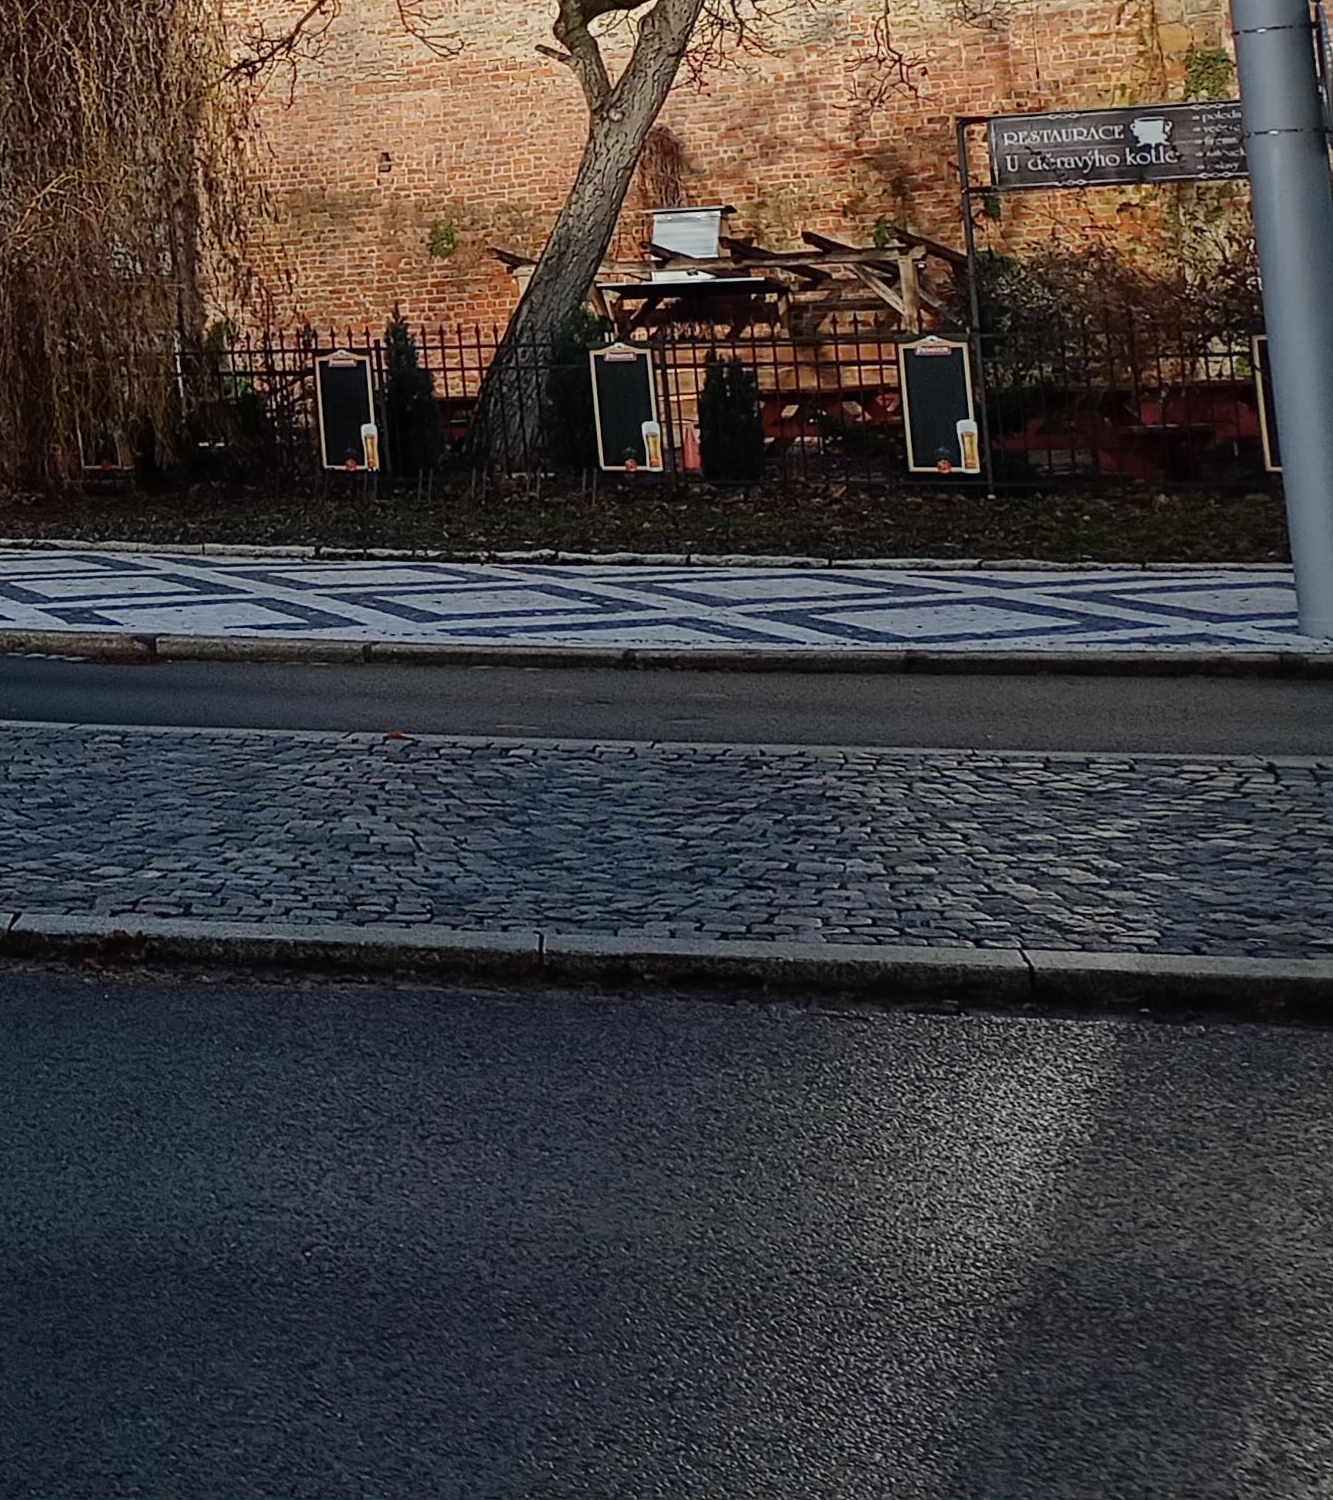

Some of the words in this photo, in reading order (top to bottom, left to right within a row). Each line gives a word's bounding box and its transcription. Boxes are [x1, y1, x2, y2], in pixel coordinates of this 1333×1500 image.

[1003, 124, 1124, 147] RESTAURACE
[1005, 155, 1019, 172] U
[1028, 151, 1121, 174] děravýho
